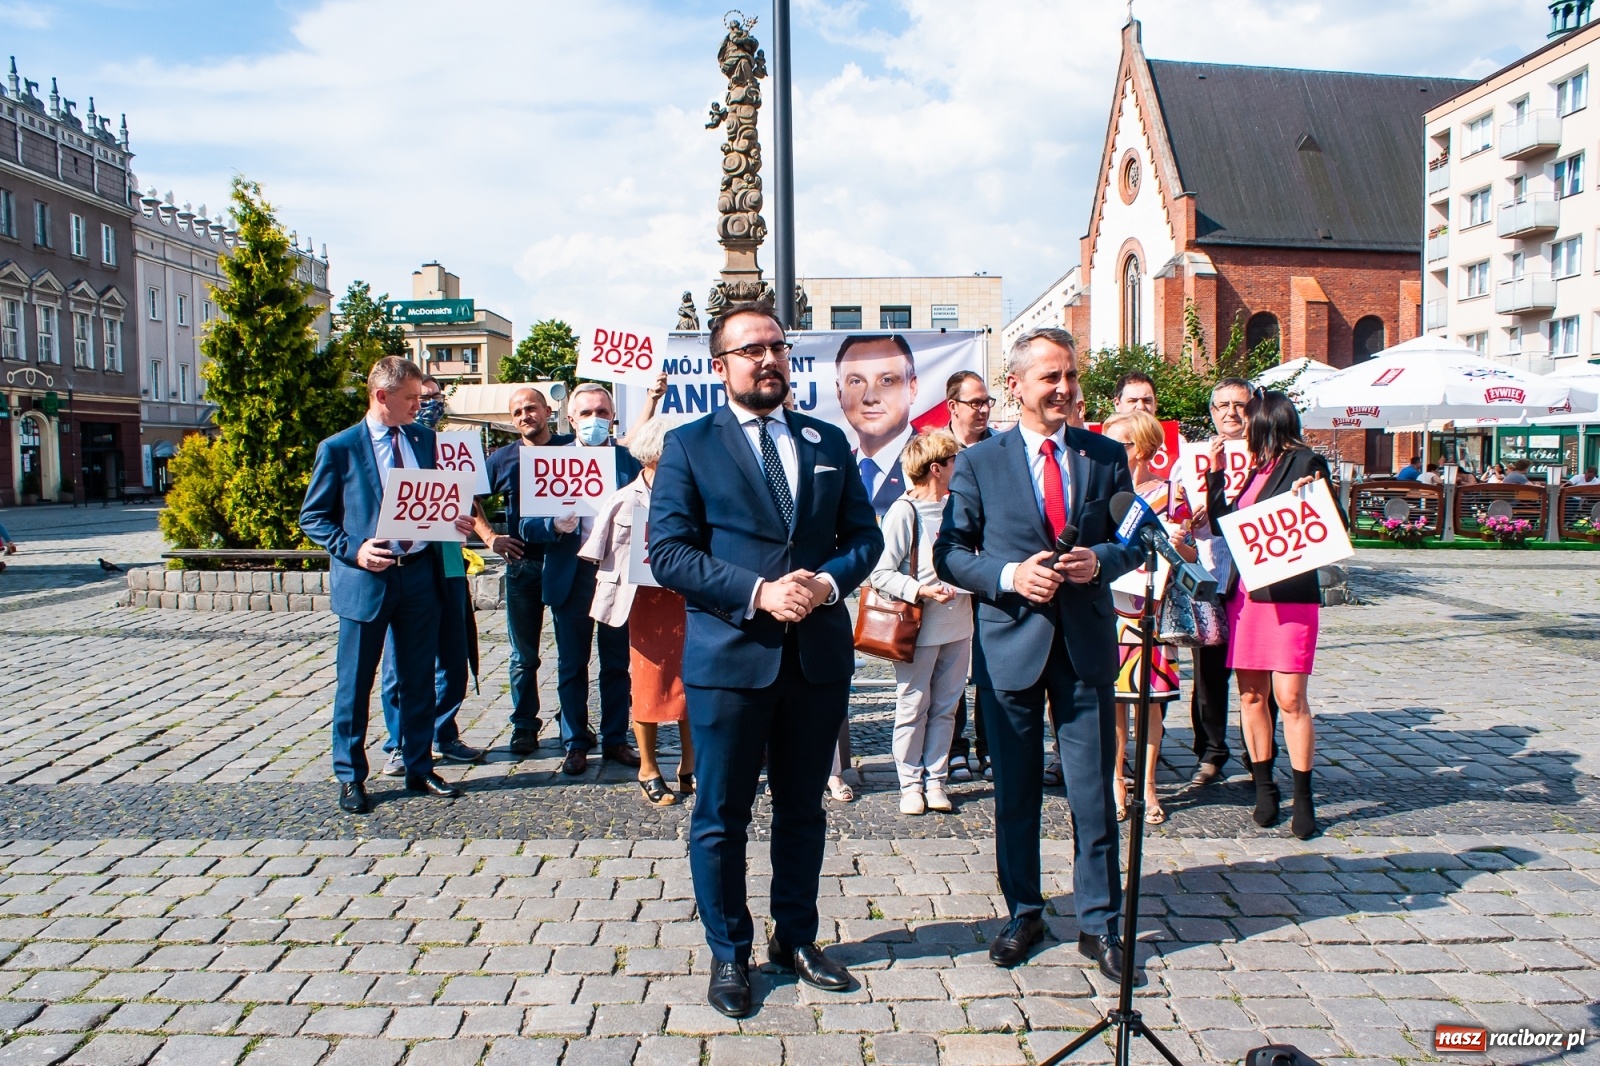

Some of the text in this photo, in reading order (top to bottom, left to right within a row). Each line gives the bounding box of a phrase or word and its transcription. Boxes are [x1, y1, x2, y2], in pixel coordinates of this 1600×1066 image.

[407, 307, 452, 316] McDonald's
[593, 328, 653, 354] DUDA
[591, 346, 653, 370] 2020
[662, 355, 702, 375] MÓJ
[1490, 387, 1521, 399] ŻYWIEC
[534, 458, 602, 478] DUDA
[397, 481, 460, 503] DUDA
[534, 477, 603, 498] 2020
[393, 501, 460, 522] 2020
[1238, 500, 1321, 545] DUDA
[1249, 521, 1328, 566] 2020
